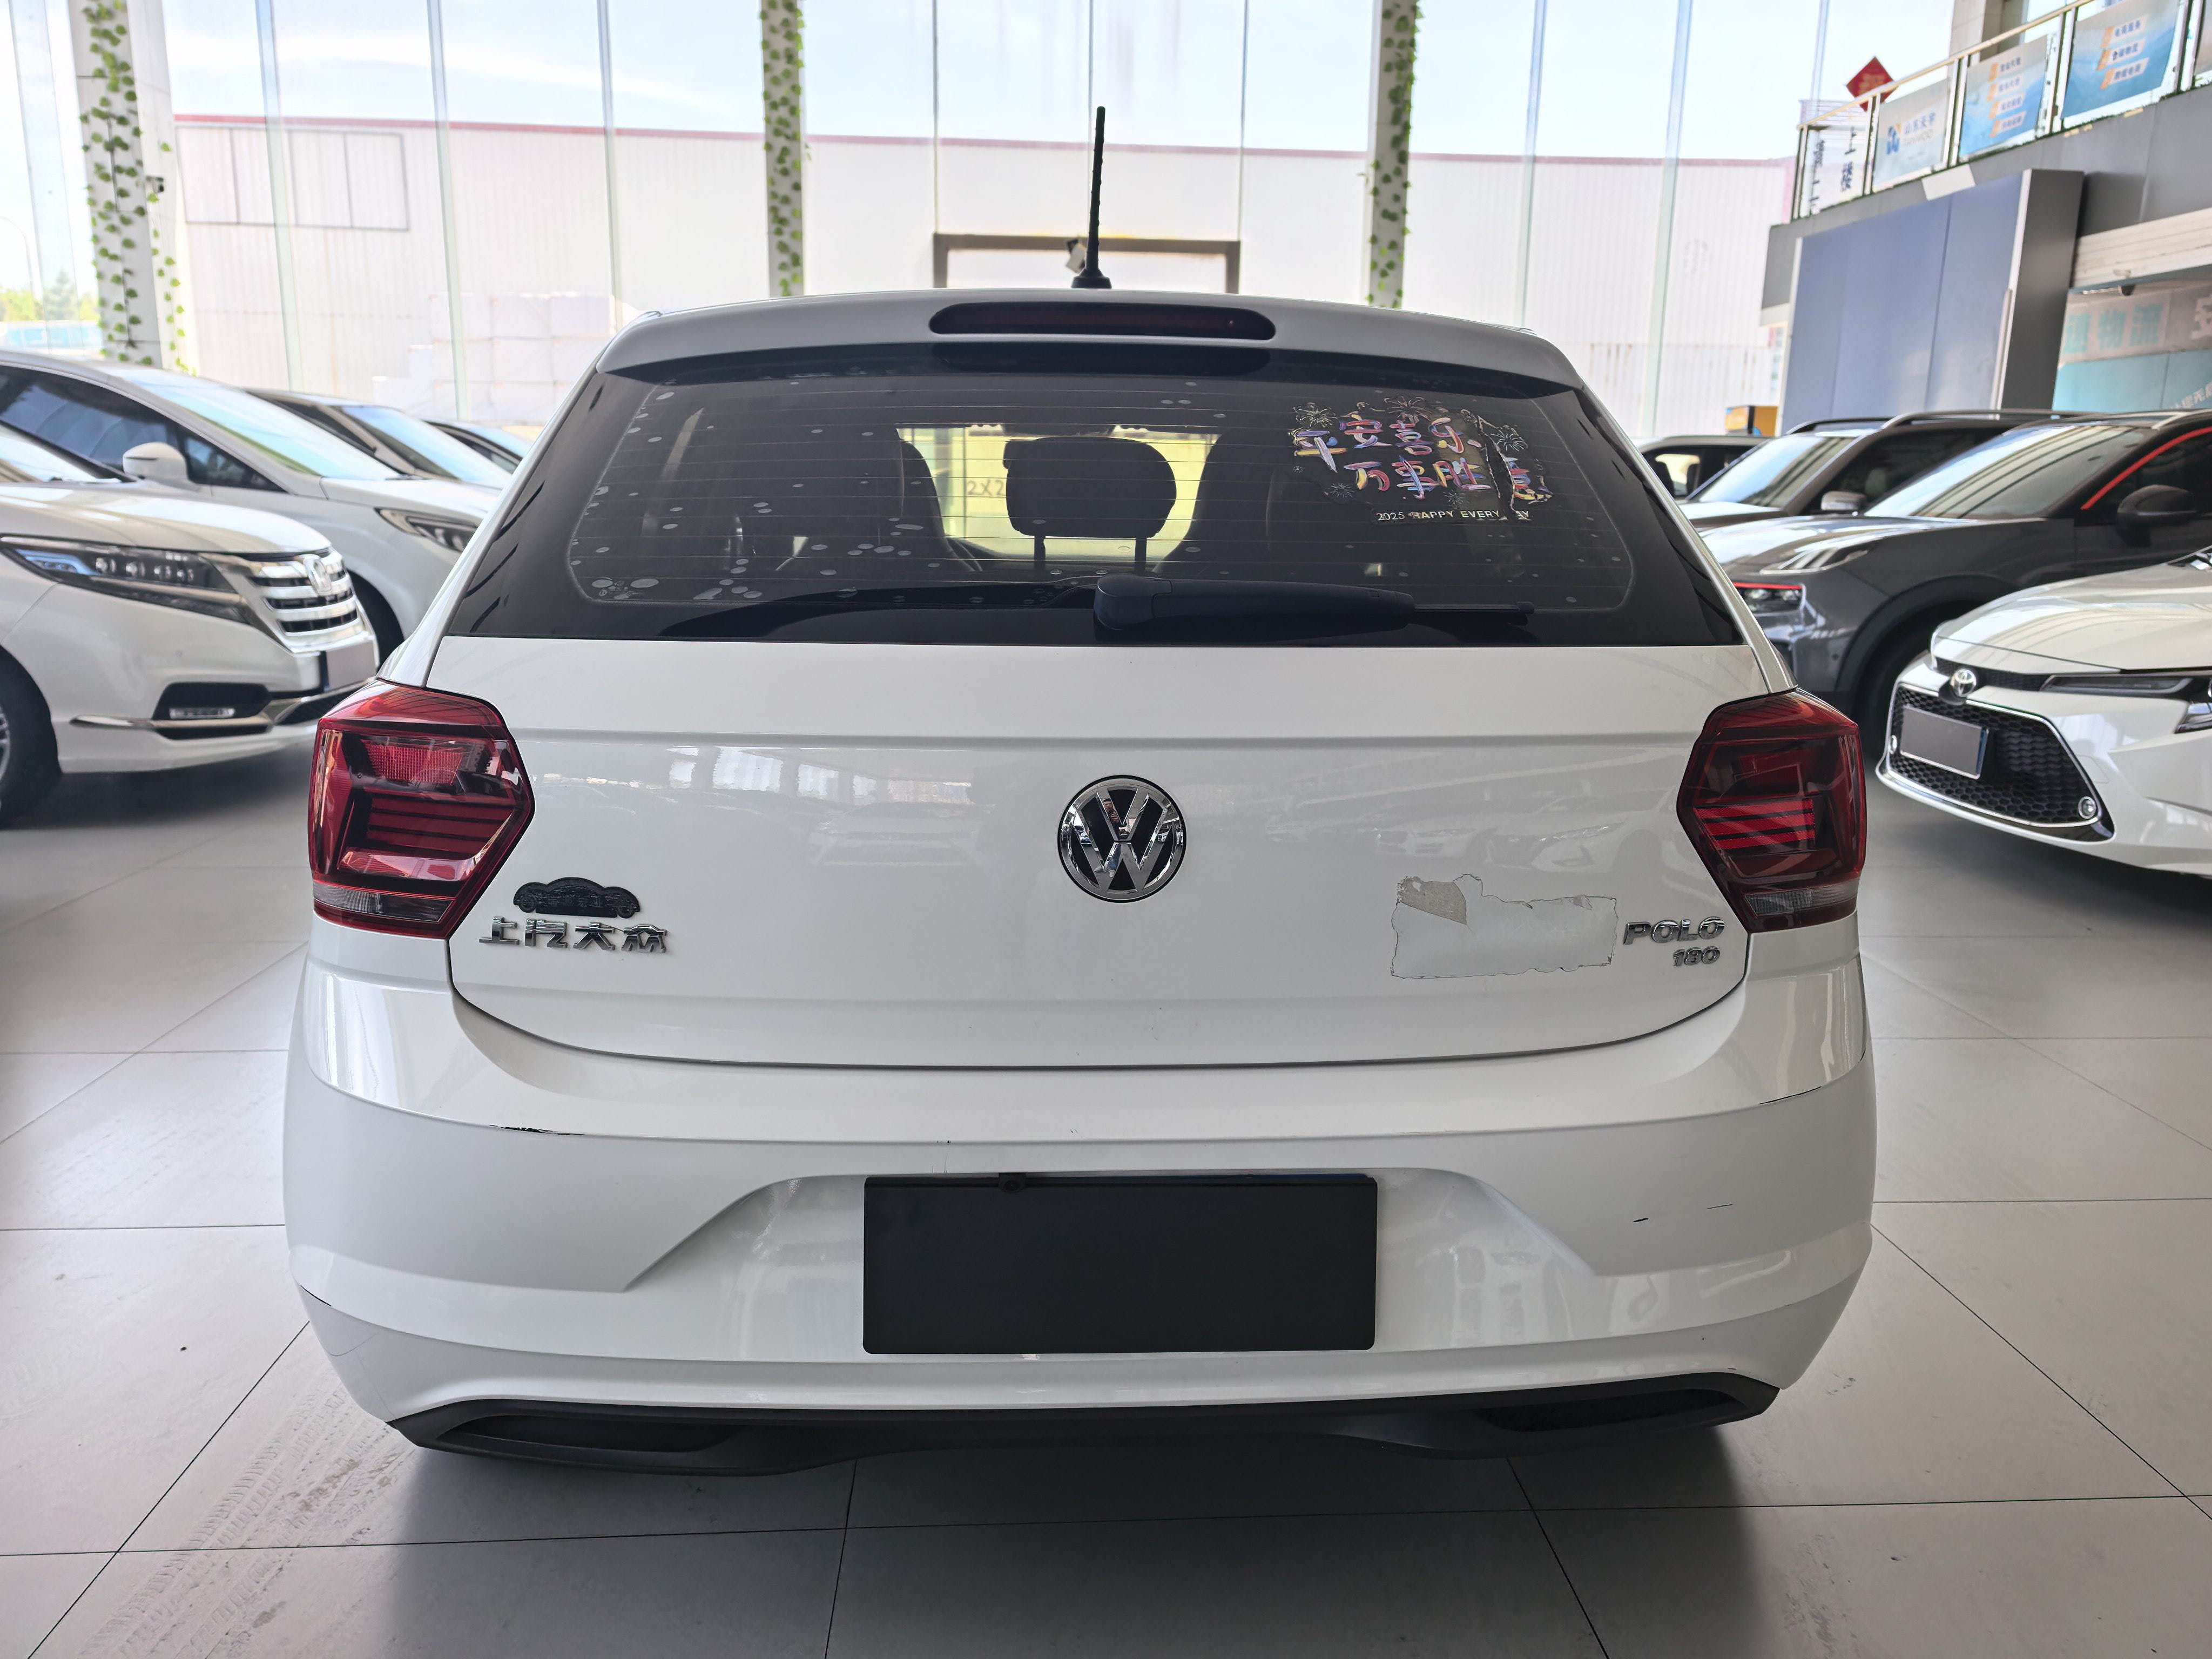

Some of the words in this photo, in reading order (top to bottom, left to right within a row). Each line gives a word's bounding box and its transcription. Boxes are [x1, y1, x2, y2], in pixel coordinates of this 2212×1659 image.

[1377, 511, 1405, 521] 2025
[1410, 510, 1454, 519] HAPPY
[1460, 510, 1500, 518] EVERY
[478, 915, 667, 954] 上汽大众
[1622, 915, 1725, 946] POLO
[1673, 946, 1721, 968] 180
